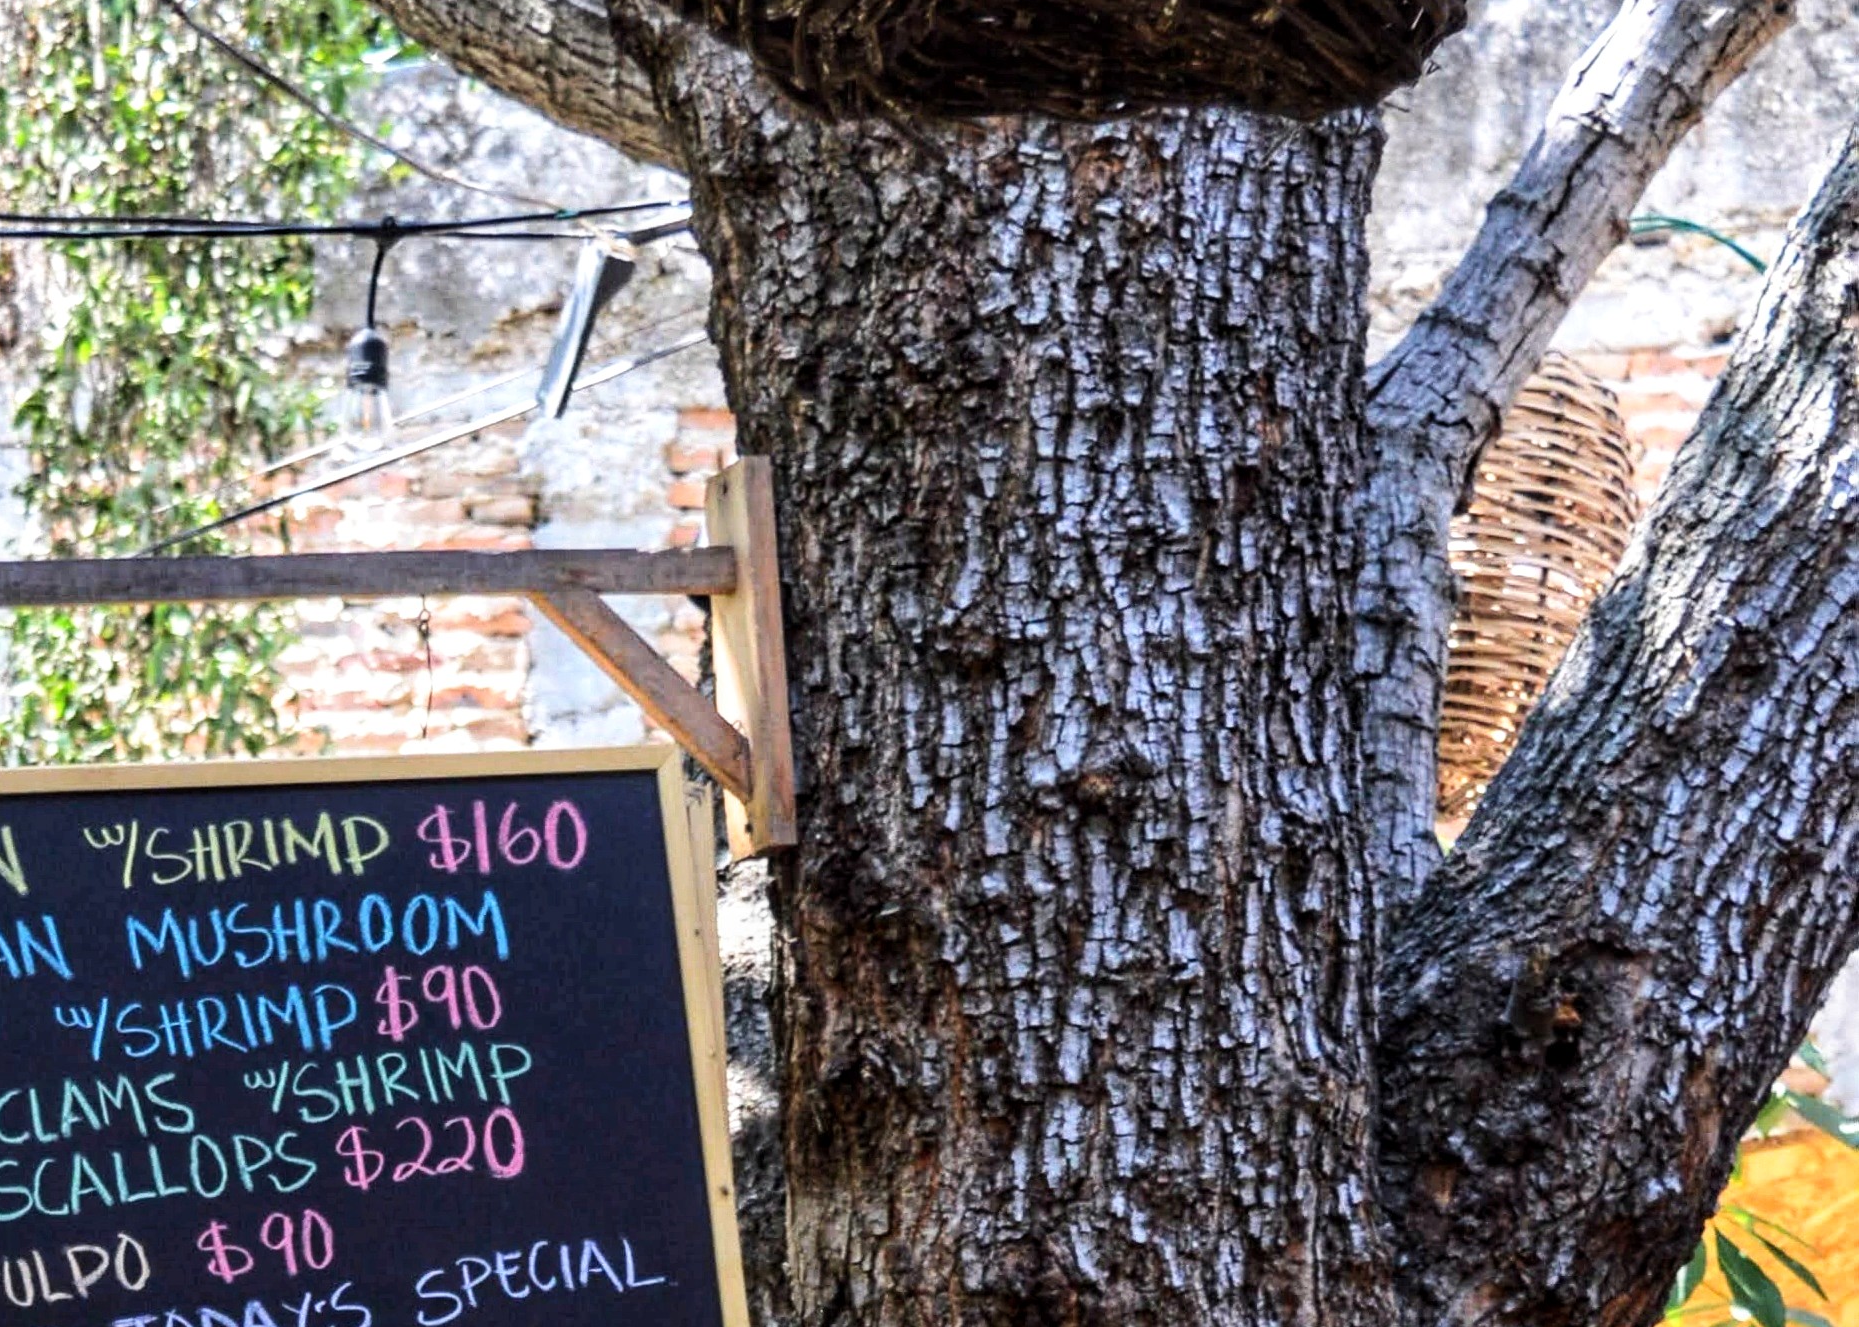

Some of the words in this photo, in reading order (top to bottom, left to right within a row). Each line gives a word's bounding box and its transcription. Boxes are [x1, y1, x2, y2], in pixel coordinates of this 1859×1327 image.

[416, 798, 590, 875] $160
[124, 887, 510, 980] MUSHROOM
[374, 964, 504, 1043] $90
[334, 1104, 528, 1192] $220
[195, 1208, 335, 1284] $90
[413, 1237, 667, 1327] SPECIAL
